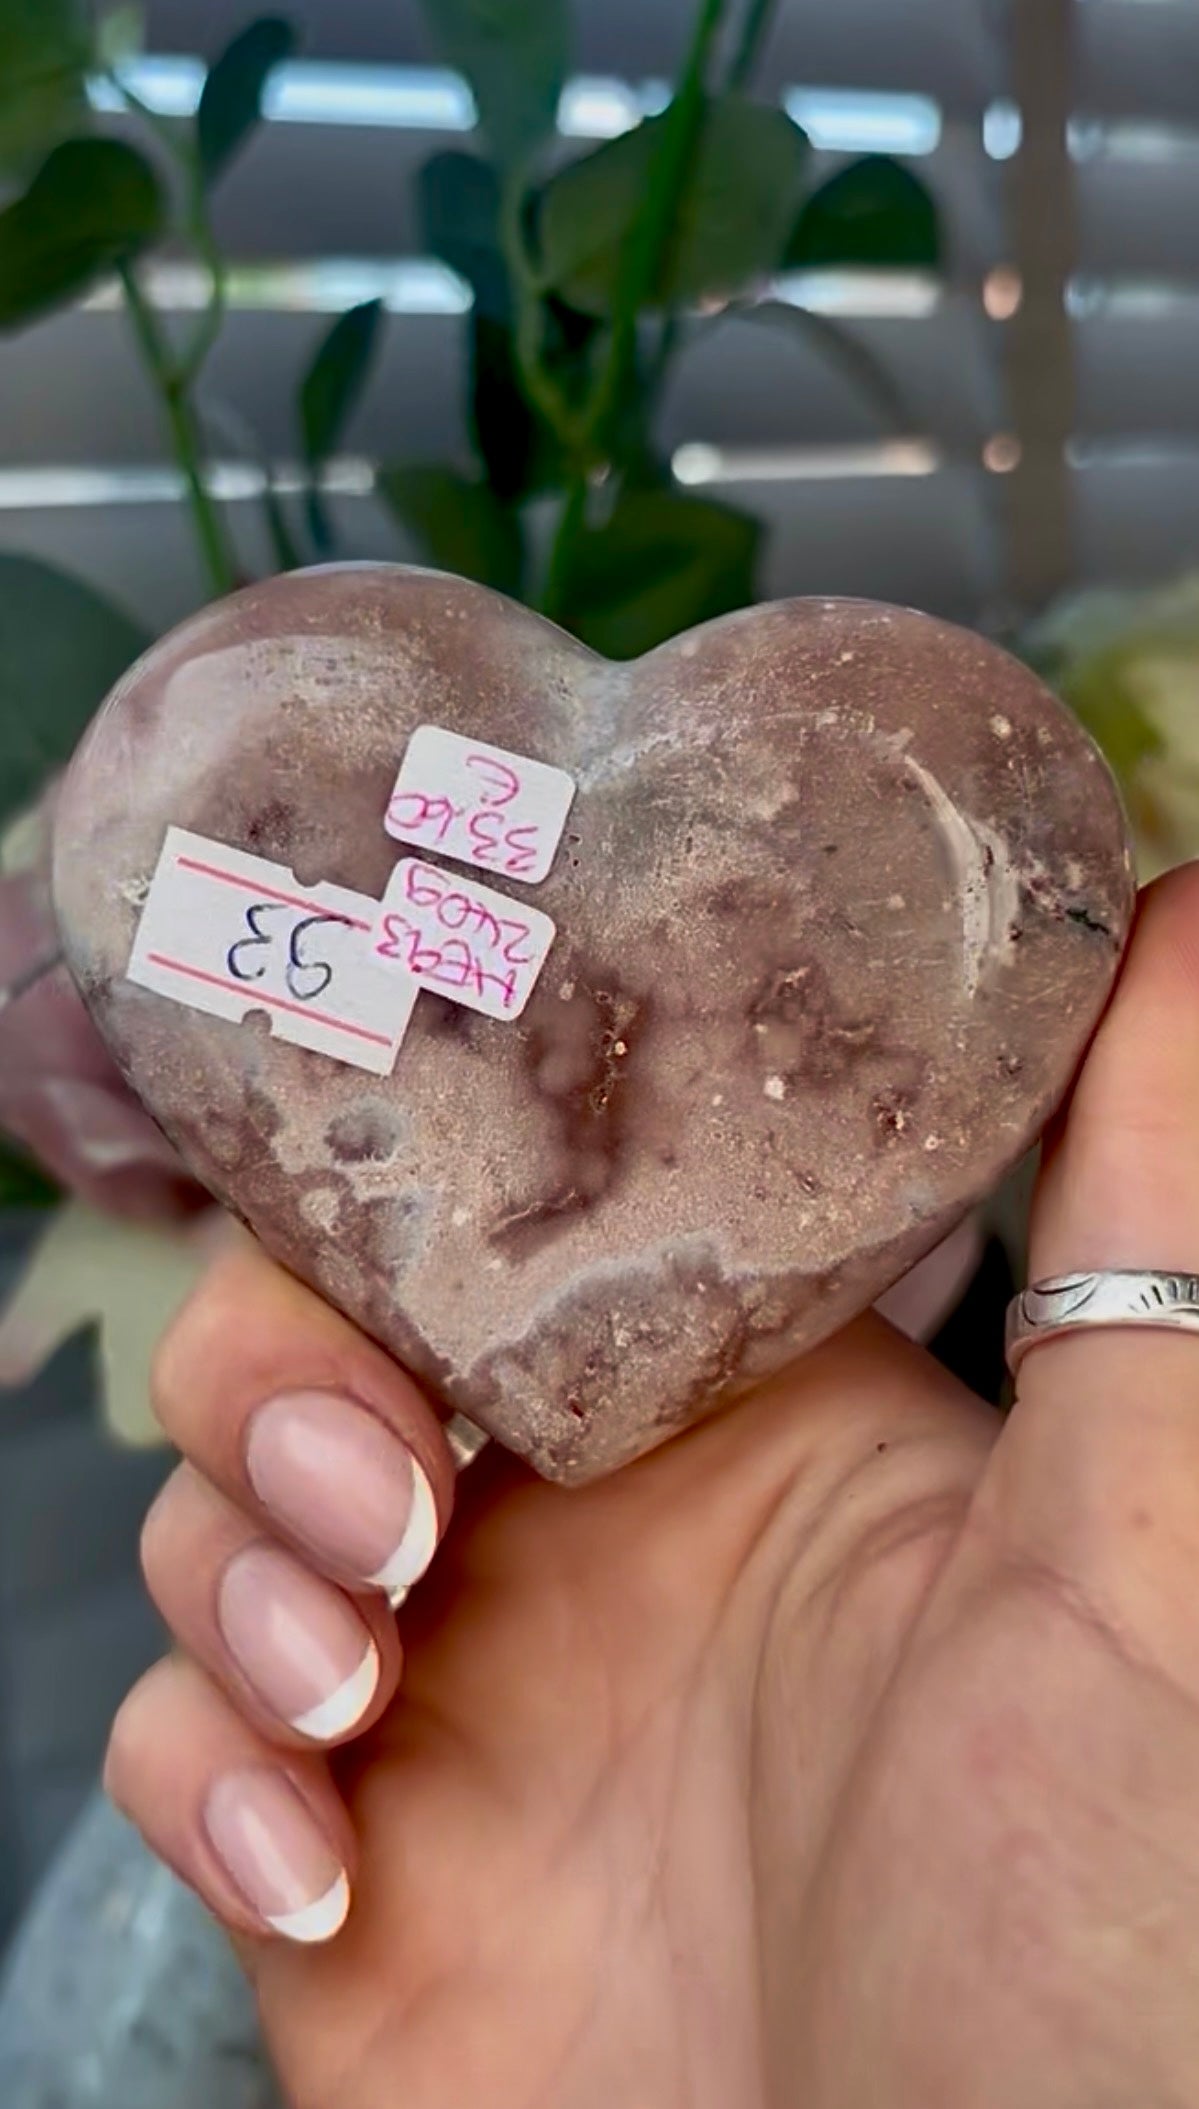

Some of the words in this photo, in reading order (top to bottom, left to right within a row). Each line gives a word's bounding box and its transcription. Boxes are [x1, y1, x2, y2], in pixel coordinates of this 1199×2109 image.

[465, 754, 520, 807] €
[227, 902, 355, 1001] 93
[405, 864, 533, 964] 240g
